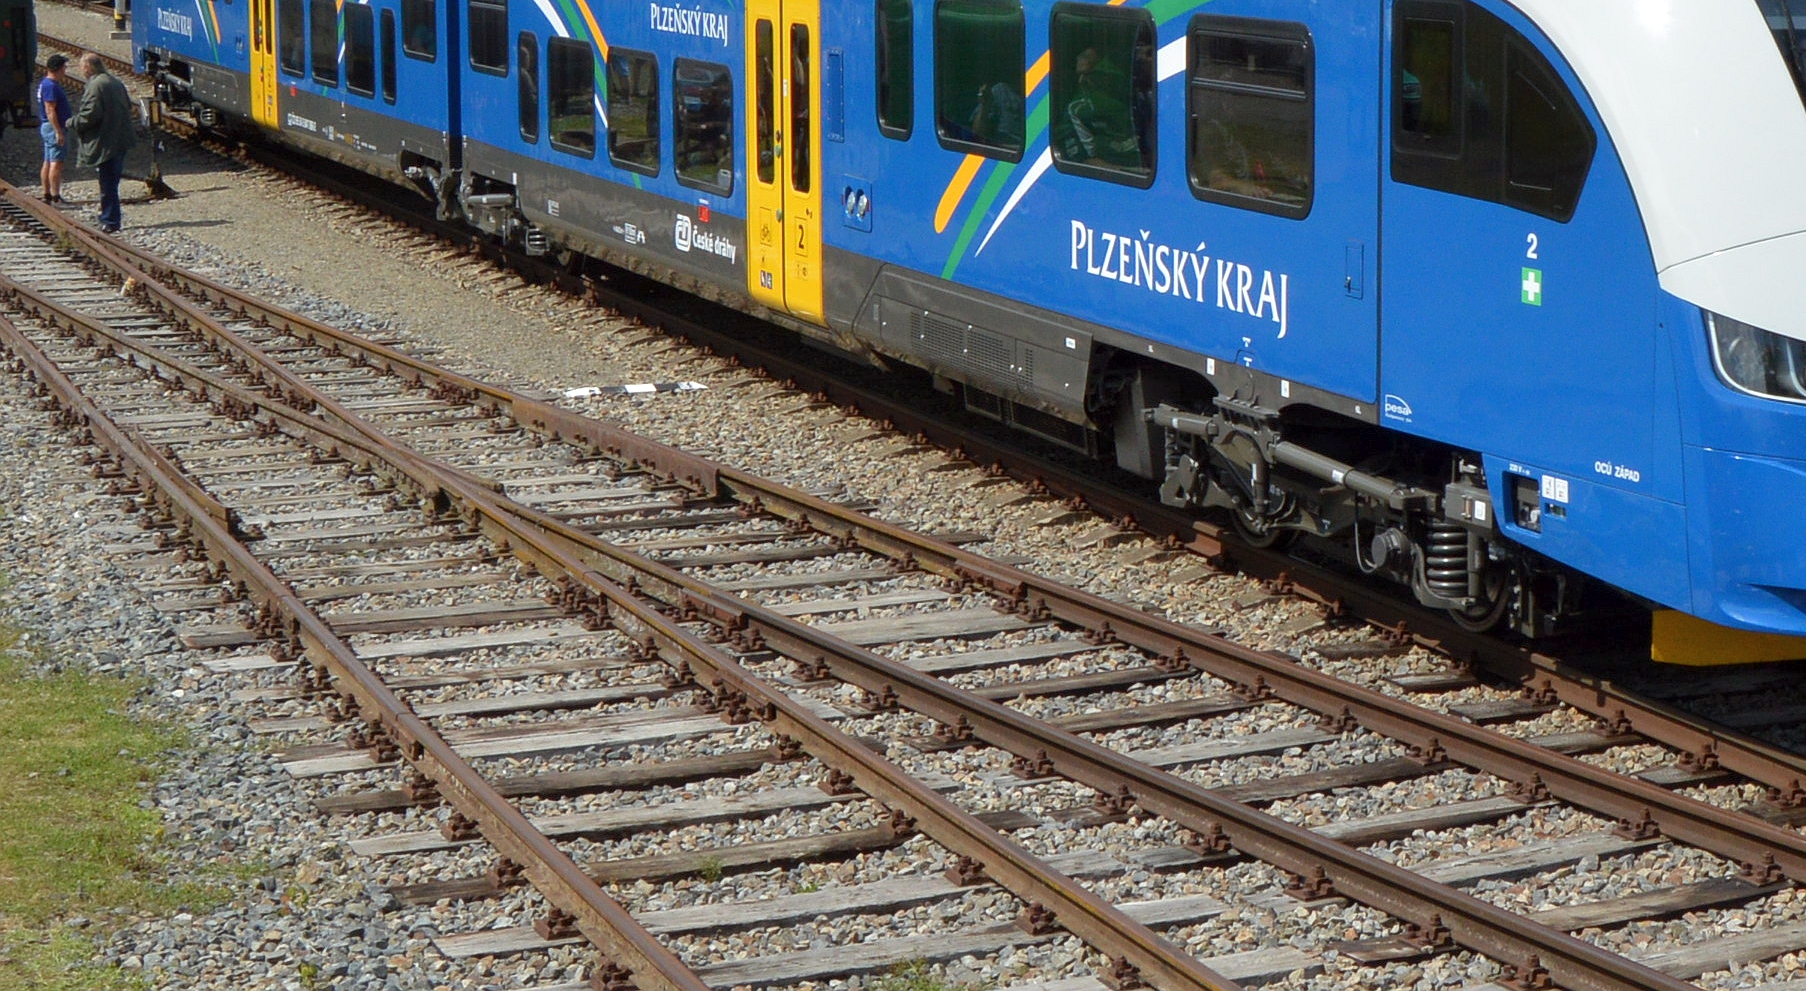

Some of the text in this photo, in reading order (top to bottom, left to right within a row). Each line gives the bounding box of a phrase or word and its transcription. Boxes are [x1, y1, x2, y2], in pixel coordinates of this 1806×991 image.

[650, 2, 728, 47] PLZEŇSKÝ KRAJ
[692, 225, 737, 265] České dráhy
[798, 224, 805, 249] 2
[1526, 232, 1538, 259] 2
[1070, 219, 1288, 340] PLZEŇSKÝ KRAJ
[1385, 403, 1410, 416] pesa
[1614, 465, 1640, 483] ZÁPAD
